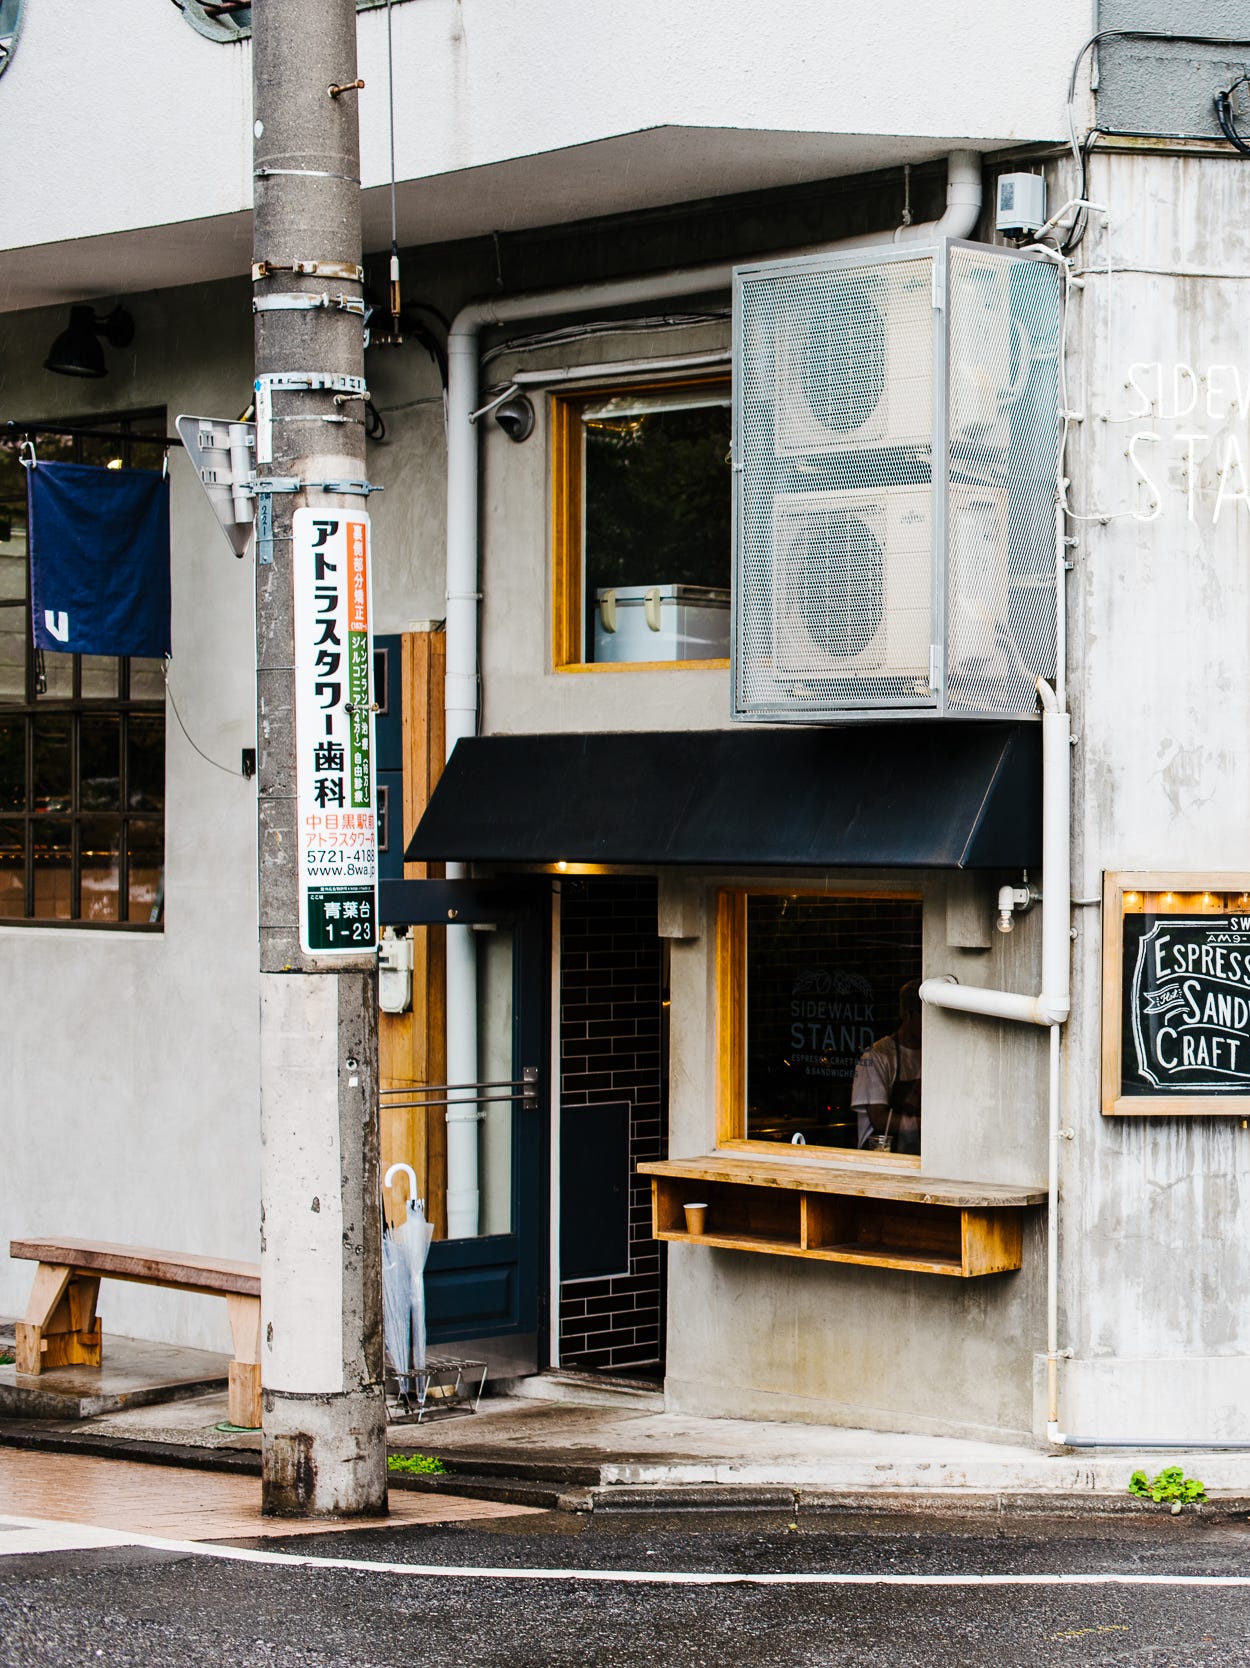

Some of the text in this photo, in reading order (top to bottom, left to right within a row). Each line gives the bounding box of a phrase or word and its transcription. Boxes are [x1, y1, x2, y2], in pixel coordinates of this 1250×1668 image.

[311, 520, 346, 809] アトラスタワー歯科
[305, 813, 375, 830] 中目黒駅前
[323, 900, 371, 919] 青葉台
[1159, 989, 1179, 1005] Hot
[790, 999, 875, 1022] SIDEWALK
[790, 1022, 875, 1053] STAND
[1155, 1027, 1240, 1071] CRAFT
